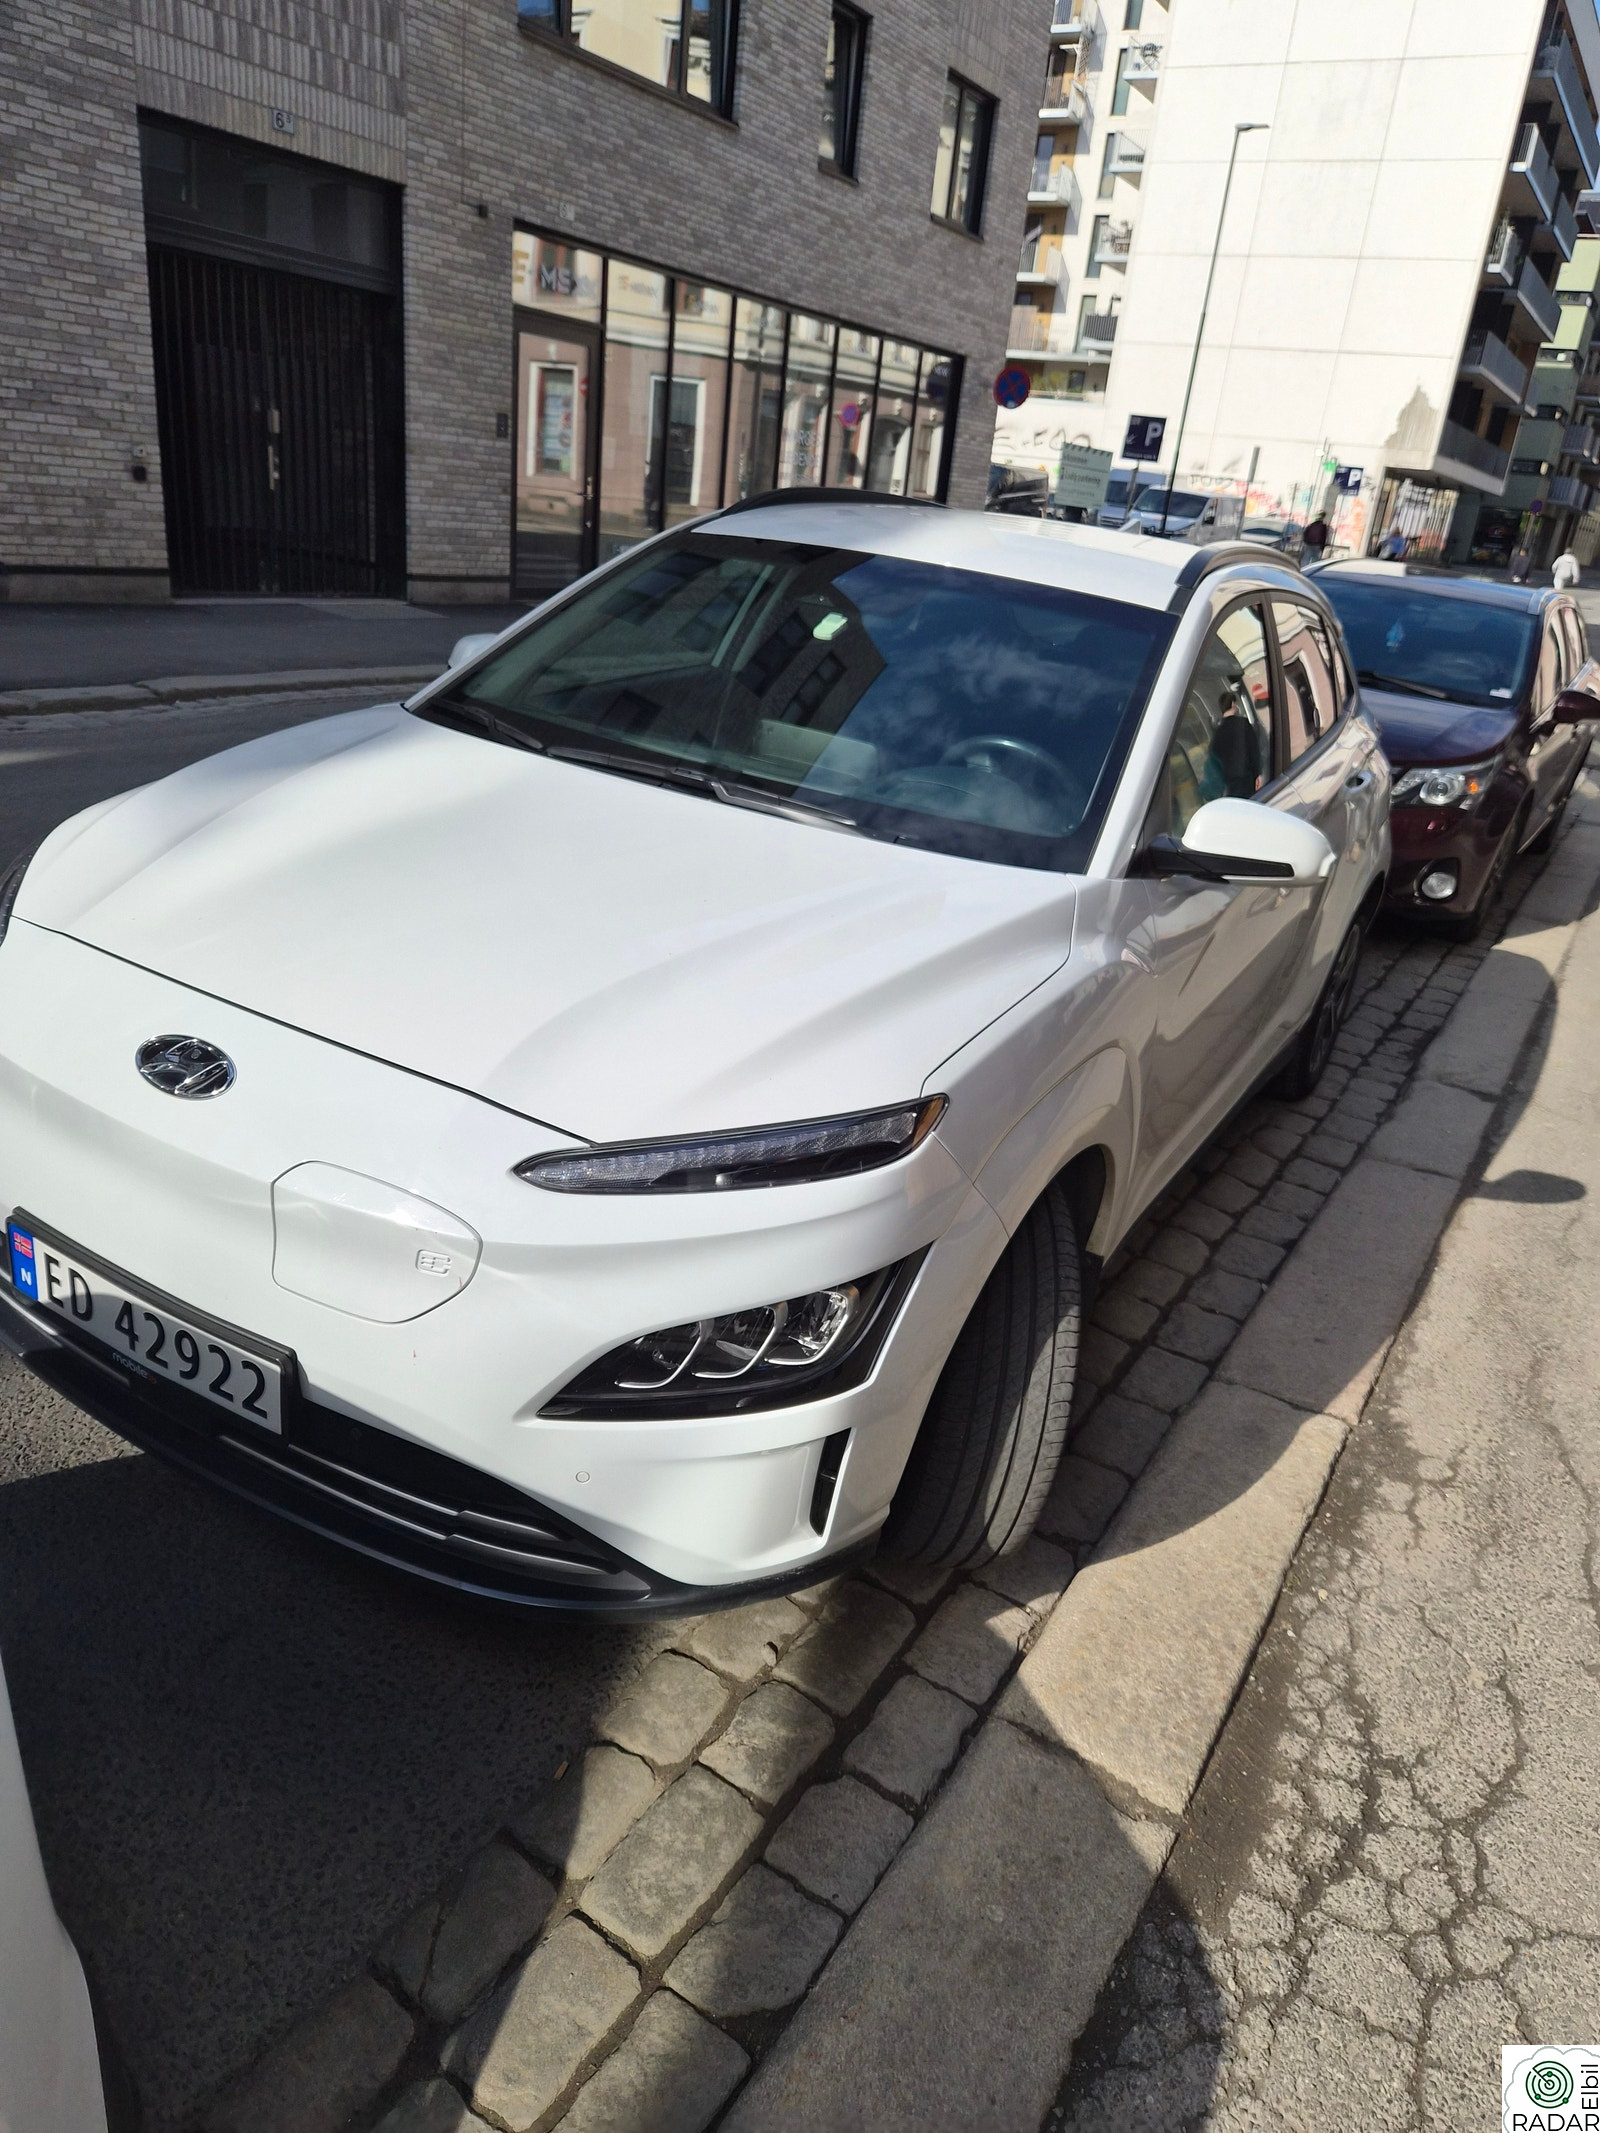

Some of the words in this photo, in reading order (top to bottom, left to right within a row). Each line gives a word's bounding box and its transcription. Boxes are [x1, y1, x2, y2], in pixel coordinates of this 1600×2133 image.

[1145, 421, 1162, 447] P
[1348, 469, 1361, 487] P
[21, 1267, 32, 1286] N
[44, 1253, 93, 1321] ED
[114, 1302, 268, 1420] 42922
